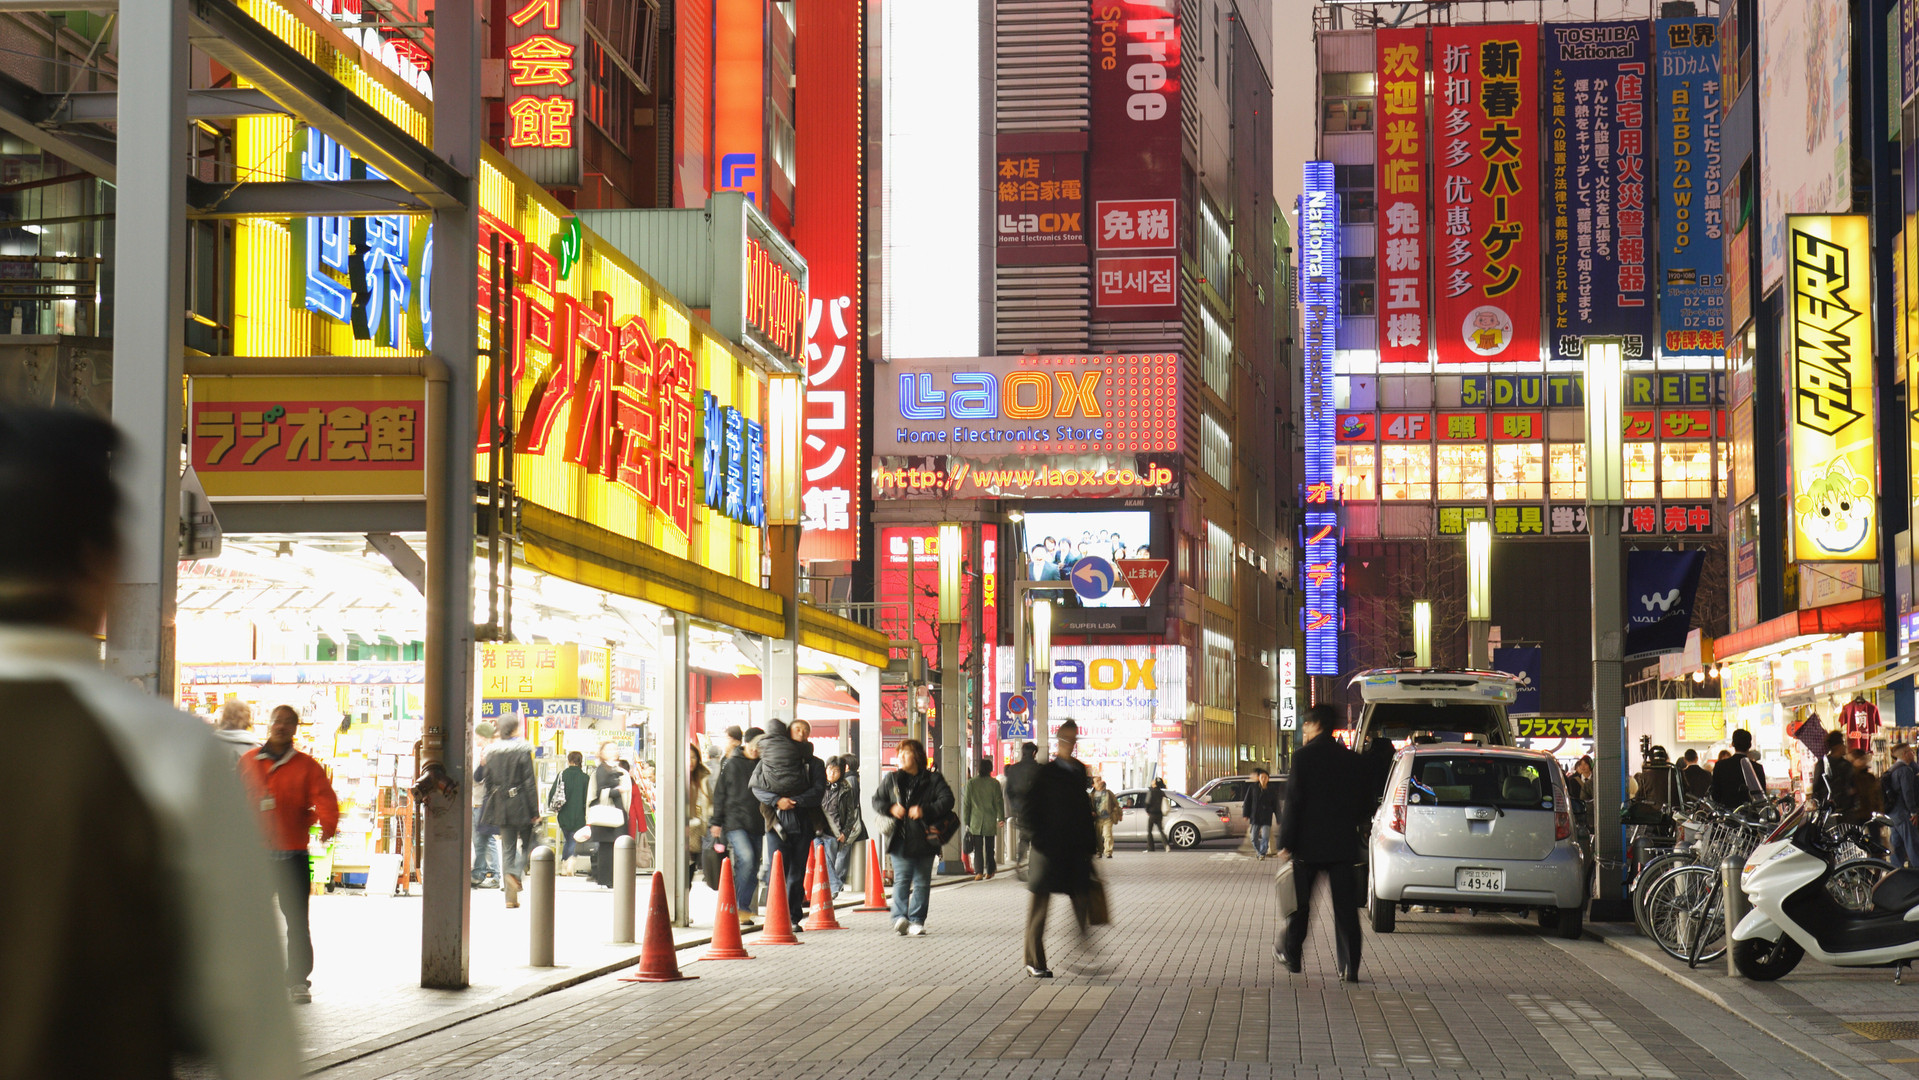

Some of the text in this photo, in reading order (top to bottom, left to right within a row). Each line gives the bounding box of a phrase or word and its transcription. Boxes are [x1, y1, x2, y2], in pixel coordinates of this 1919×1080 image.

[1101, 6, 1117, 71] Store
[1554, 26, 1640, 43] TOSHIBA
[1668, 24, 1720, 49] 世界
[1560, 42, 1634, 61] National
[1127, 17, 1175, 121] Free
[1383, 43, 1419, 194] 欢迎光临
[998, 157, 1040, 179] 本店
[1443, 44, 1473, 298] 折扣多多 优惠多多
[1480, 40, 1523, 298] 新春大バーゲン
[1593, 78, 1611, 261] かんたん設置で、火災を見張る。
[1703, 80, 1721, 240] キレイにたっぷり撮れる
[998, 179, 1081, 202] 総合家電
[1615, 62, 1645, 307] 「住宅用火災警報器」
[1574, 79, 1592, 324] 煙や熱をキャッチして、警報音で知らせます。
[998, 212, 1081, 233] Laox
[1103, 208, 1170, 241] 免税
[1021, 234, 1061, 242] Electronics
[1063, 233, 1083, 241] Store
[1309, 191, 1327, 283] National
[1101, 268, 1171, 295] 면세점
[1700, 274, 1723, 287] 日立
[1559, 334, 1643, 357] 地場
[1793, 228, 1866, 436] GAMERS
[1310, 305, 1329, 420] Panasonic
[899, 370, 1102, 420] Laox
[1463, 378, 1484, 404] 5F
[1494, 377, 1584, 404] DUT
[802, 295, 851, 531] パソコン館
[197, 405, 417, 465] ラジオ会館
[896, 424, 1104, 443] Home Electronics Store
[1388, 415, 1424, 439] 4F
[1448, 415, 1532, 439] 照明
[890, 536, 939, 555] Lao
[1307, 482, 1332, 632] オノデン
[1128, 568, 1158, 579] 止まれ
[547, 704, 578, 714] SALE
[1057, 696, 1122, 707] Electronics
[1126, 695, 1159, 707] Store
[545, 717, 579, 729] SALE
[1855, 711, 1867, 728] 萌
[1468, 878, 1499, 890] 49-46
